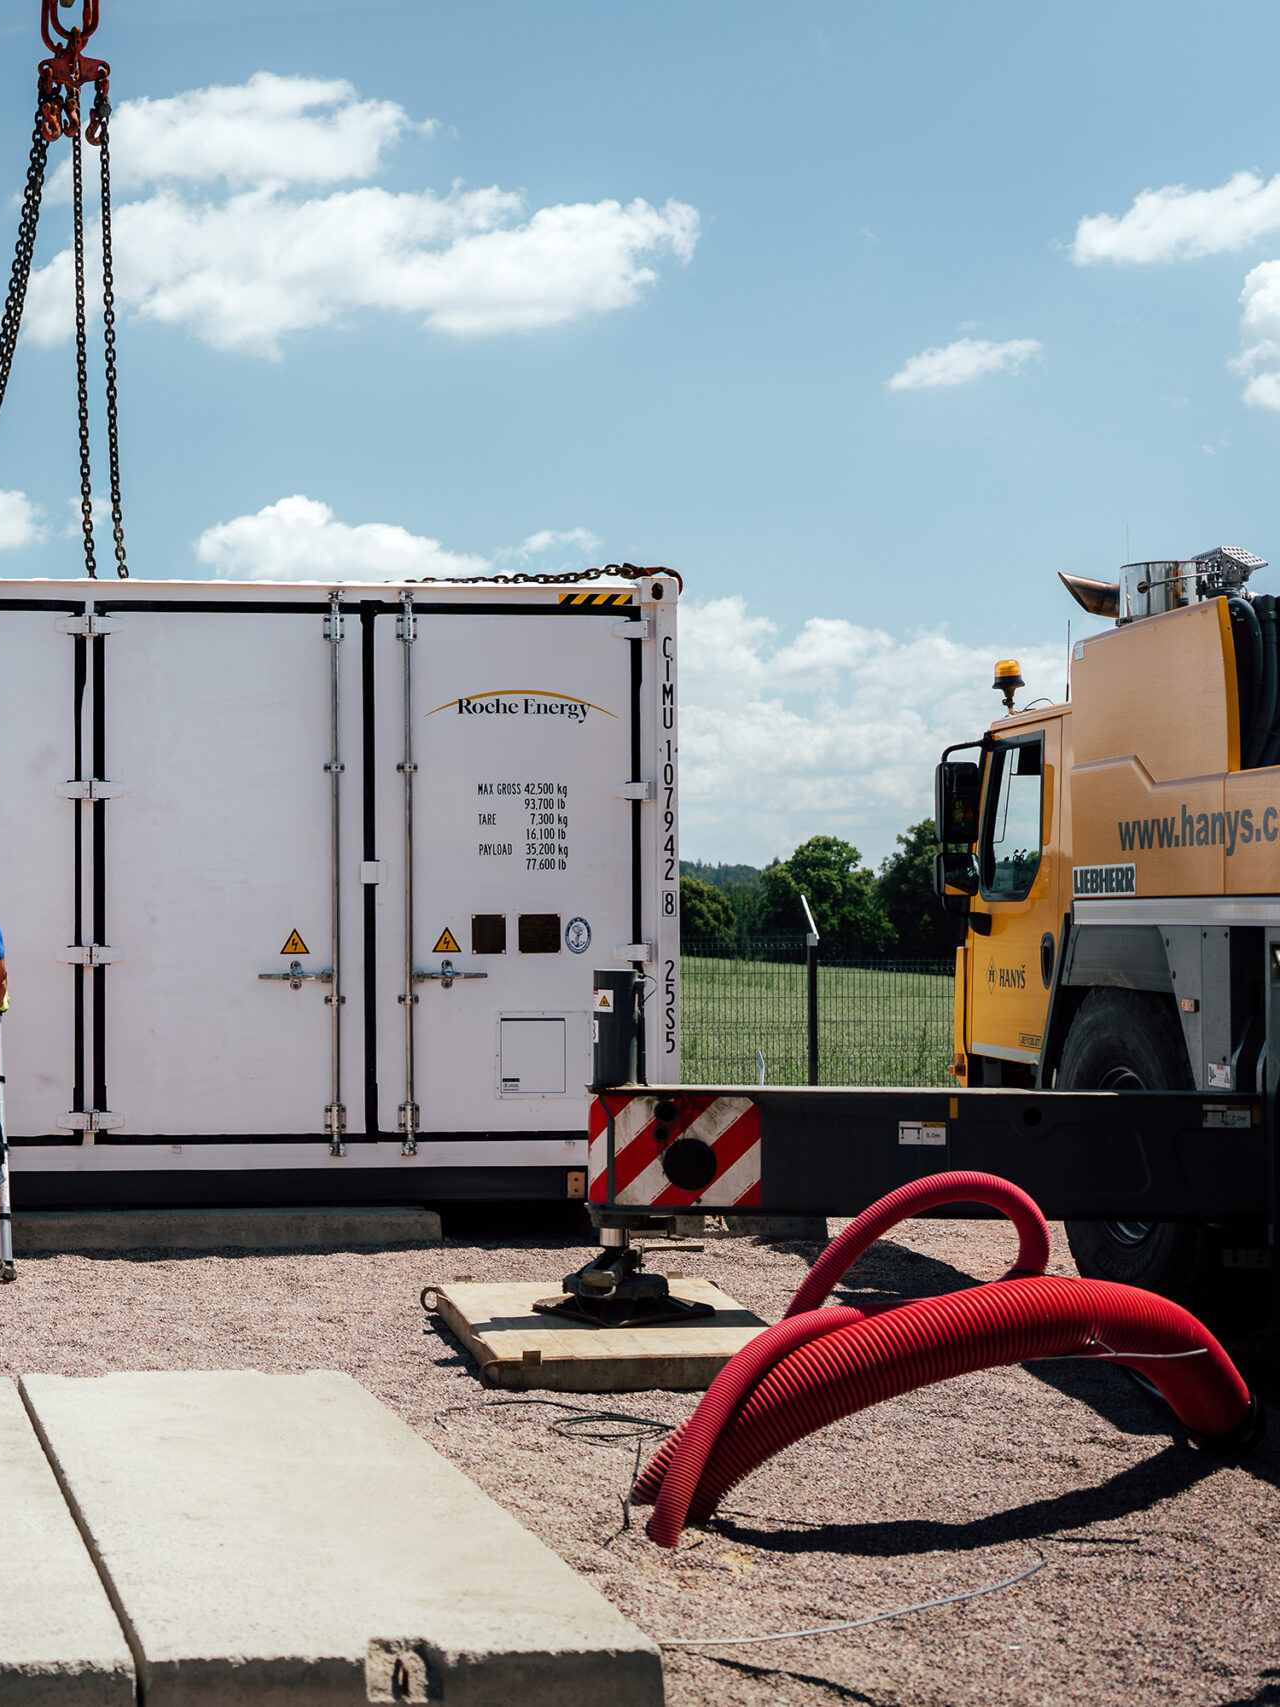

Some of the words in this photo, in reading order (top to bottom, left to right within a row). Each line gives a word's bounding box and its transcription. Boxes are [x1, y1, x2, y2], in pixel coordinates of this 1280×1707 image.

[457, 698, 519, 715] Roche
[523, 698, 591, 724] Energy
[477, 783, 494, 795] MAX
[497, 783, 521, 795] GROSS
[557, 783, 568, 798] kg
[557, 798, 566, 810] lb
[663, 739, 675, 880] 107942
[478, 813, 497, 826] TARE
[557, 813, 568, 828] kg
[1118, 804, 1280, 857] www.hanys.c
[557, 828, 567, 840] lb
[478, 843, 513, 856] PAYLOAD
[558, 843, 569, 859] kg
[558, 858, 567, 871] lb
[1073, 866, 1135, 894] LIEBHERR
[663, 892, 675, 916] 8
[999, 964, 1026, 989] HANYŠ
[665, 960, 676, 1054] 25S5
